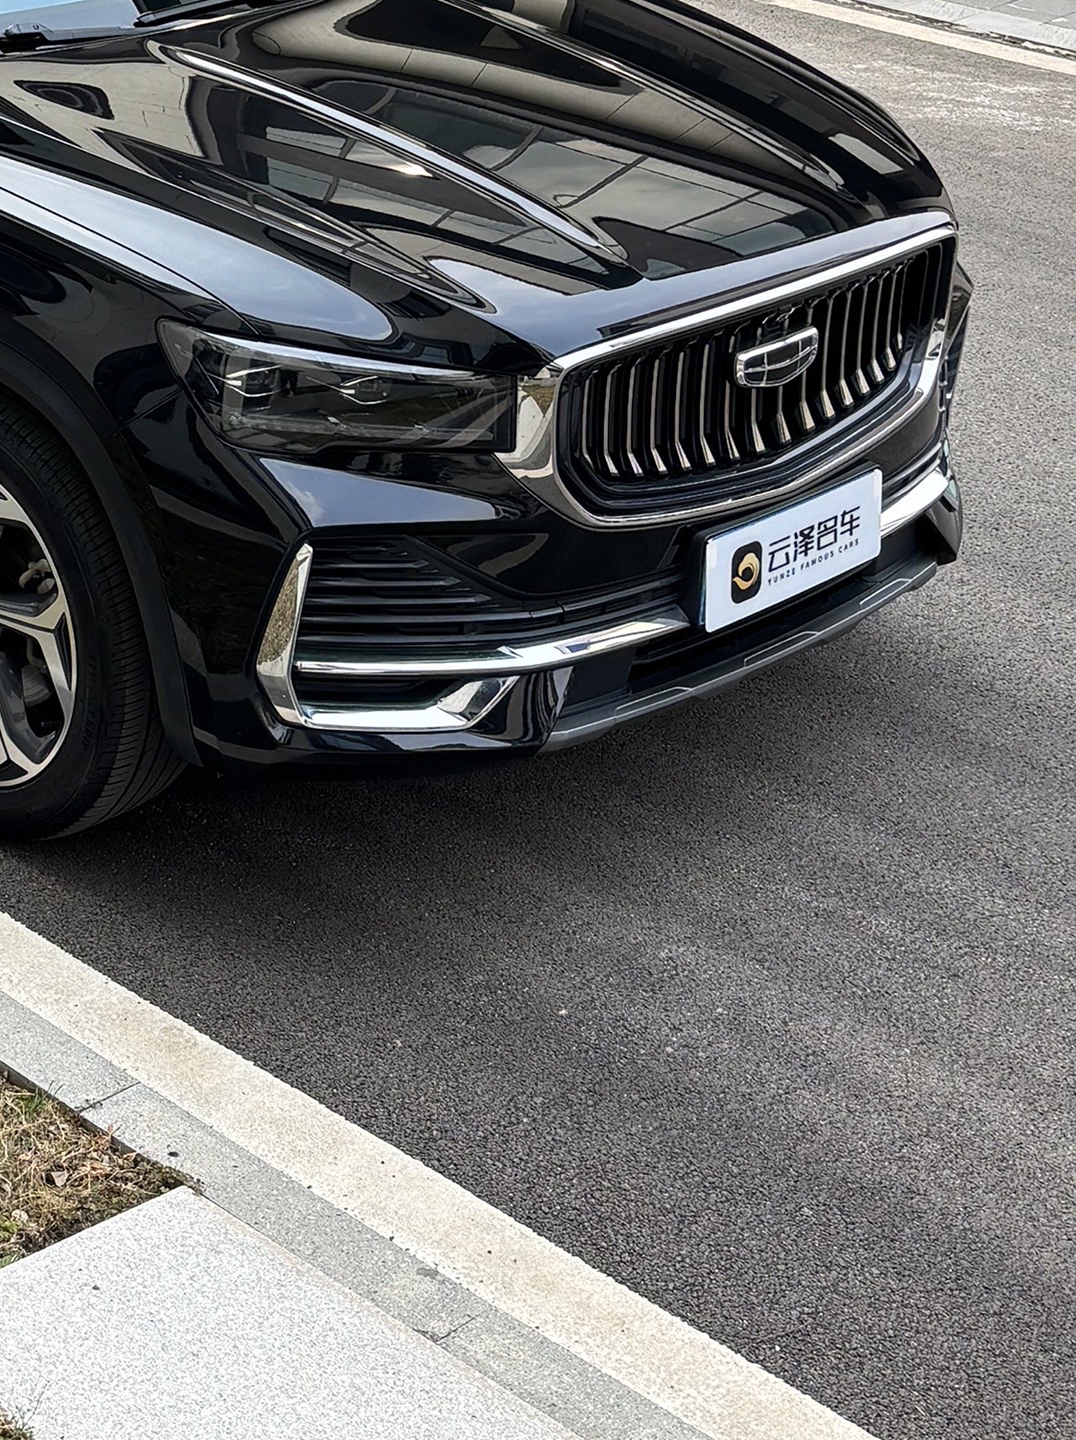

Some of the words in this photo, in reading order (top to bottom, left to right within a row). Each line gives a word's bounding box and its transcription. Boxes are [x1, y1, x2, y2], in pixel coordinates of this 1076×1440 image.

[768, 505, 861, 573] 云泽名车
[768, 567, 796, 586] YUNZE
[800, 550, 835, 571] FAMOUS
[838, 538, 859, 554] CARS
